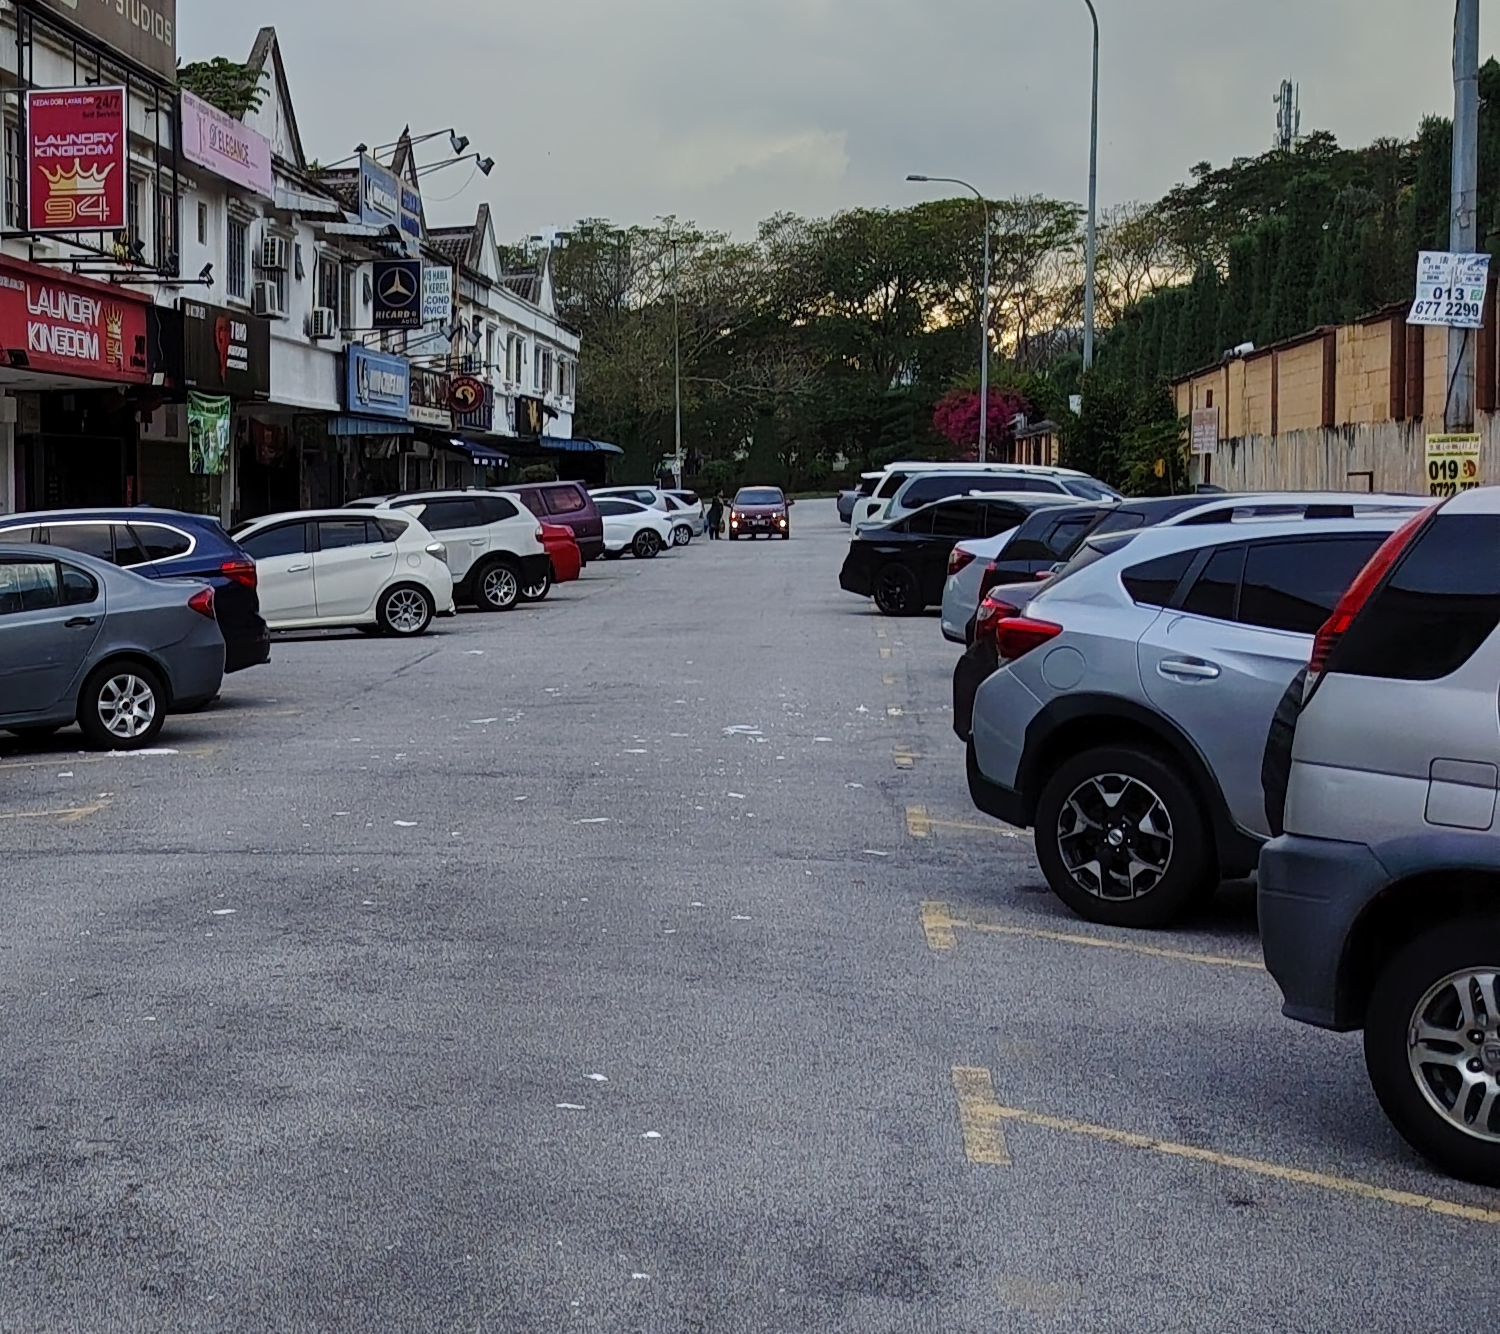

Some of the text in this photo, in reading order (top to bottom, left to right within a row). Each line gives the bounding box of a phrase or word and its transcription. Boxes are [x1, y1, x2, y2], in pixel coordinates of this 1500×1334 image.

[94, 95, 120, 109] 24/7
[34, 132, 119, 146] LAUNDRY
[34, 144, 114, 157] KINGDOM
[44, 196, 110, 224] 94
[428, 281, 450, 295] KERETA
[1432, 286, 1465, 301] 013
[26, 283, 102, 328] LAUNDRY
[1414, 300, 1479, 318] 677 2299
[26, 320, 100, 361] KINGDOM
[1428, 459, 1458, 481] 019
